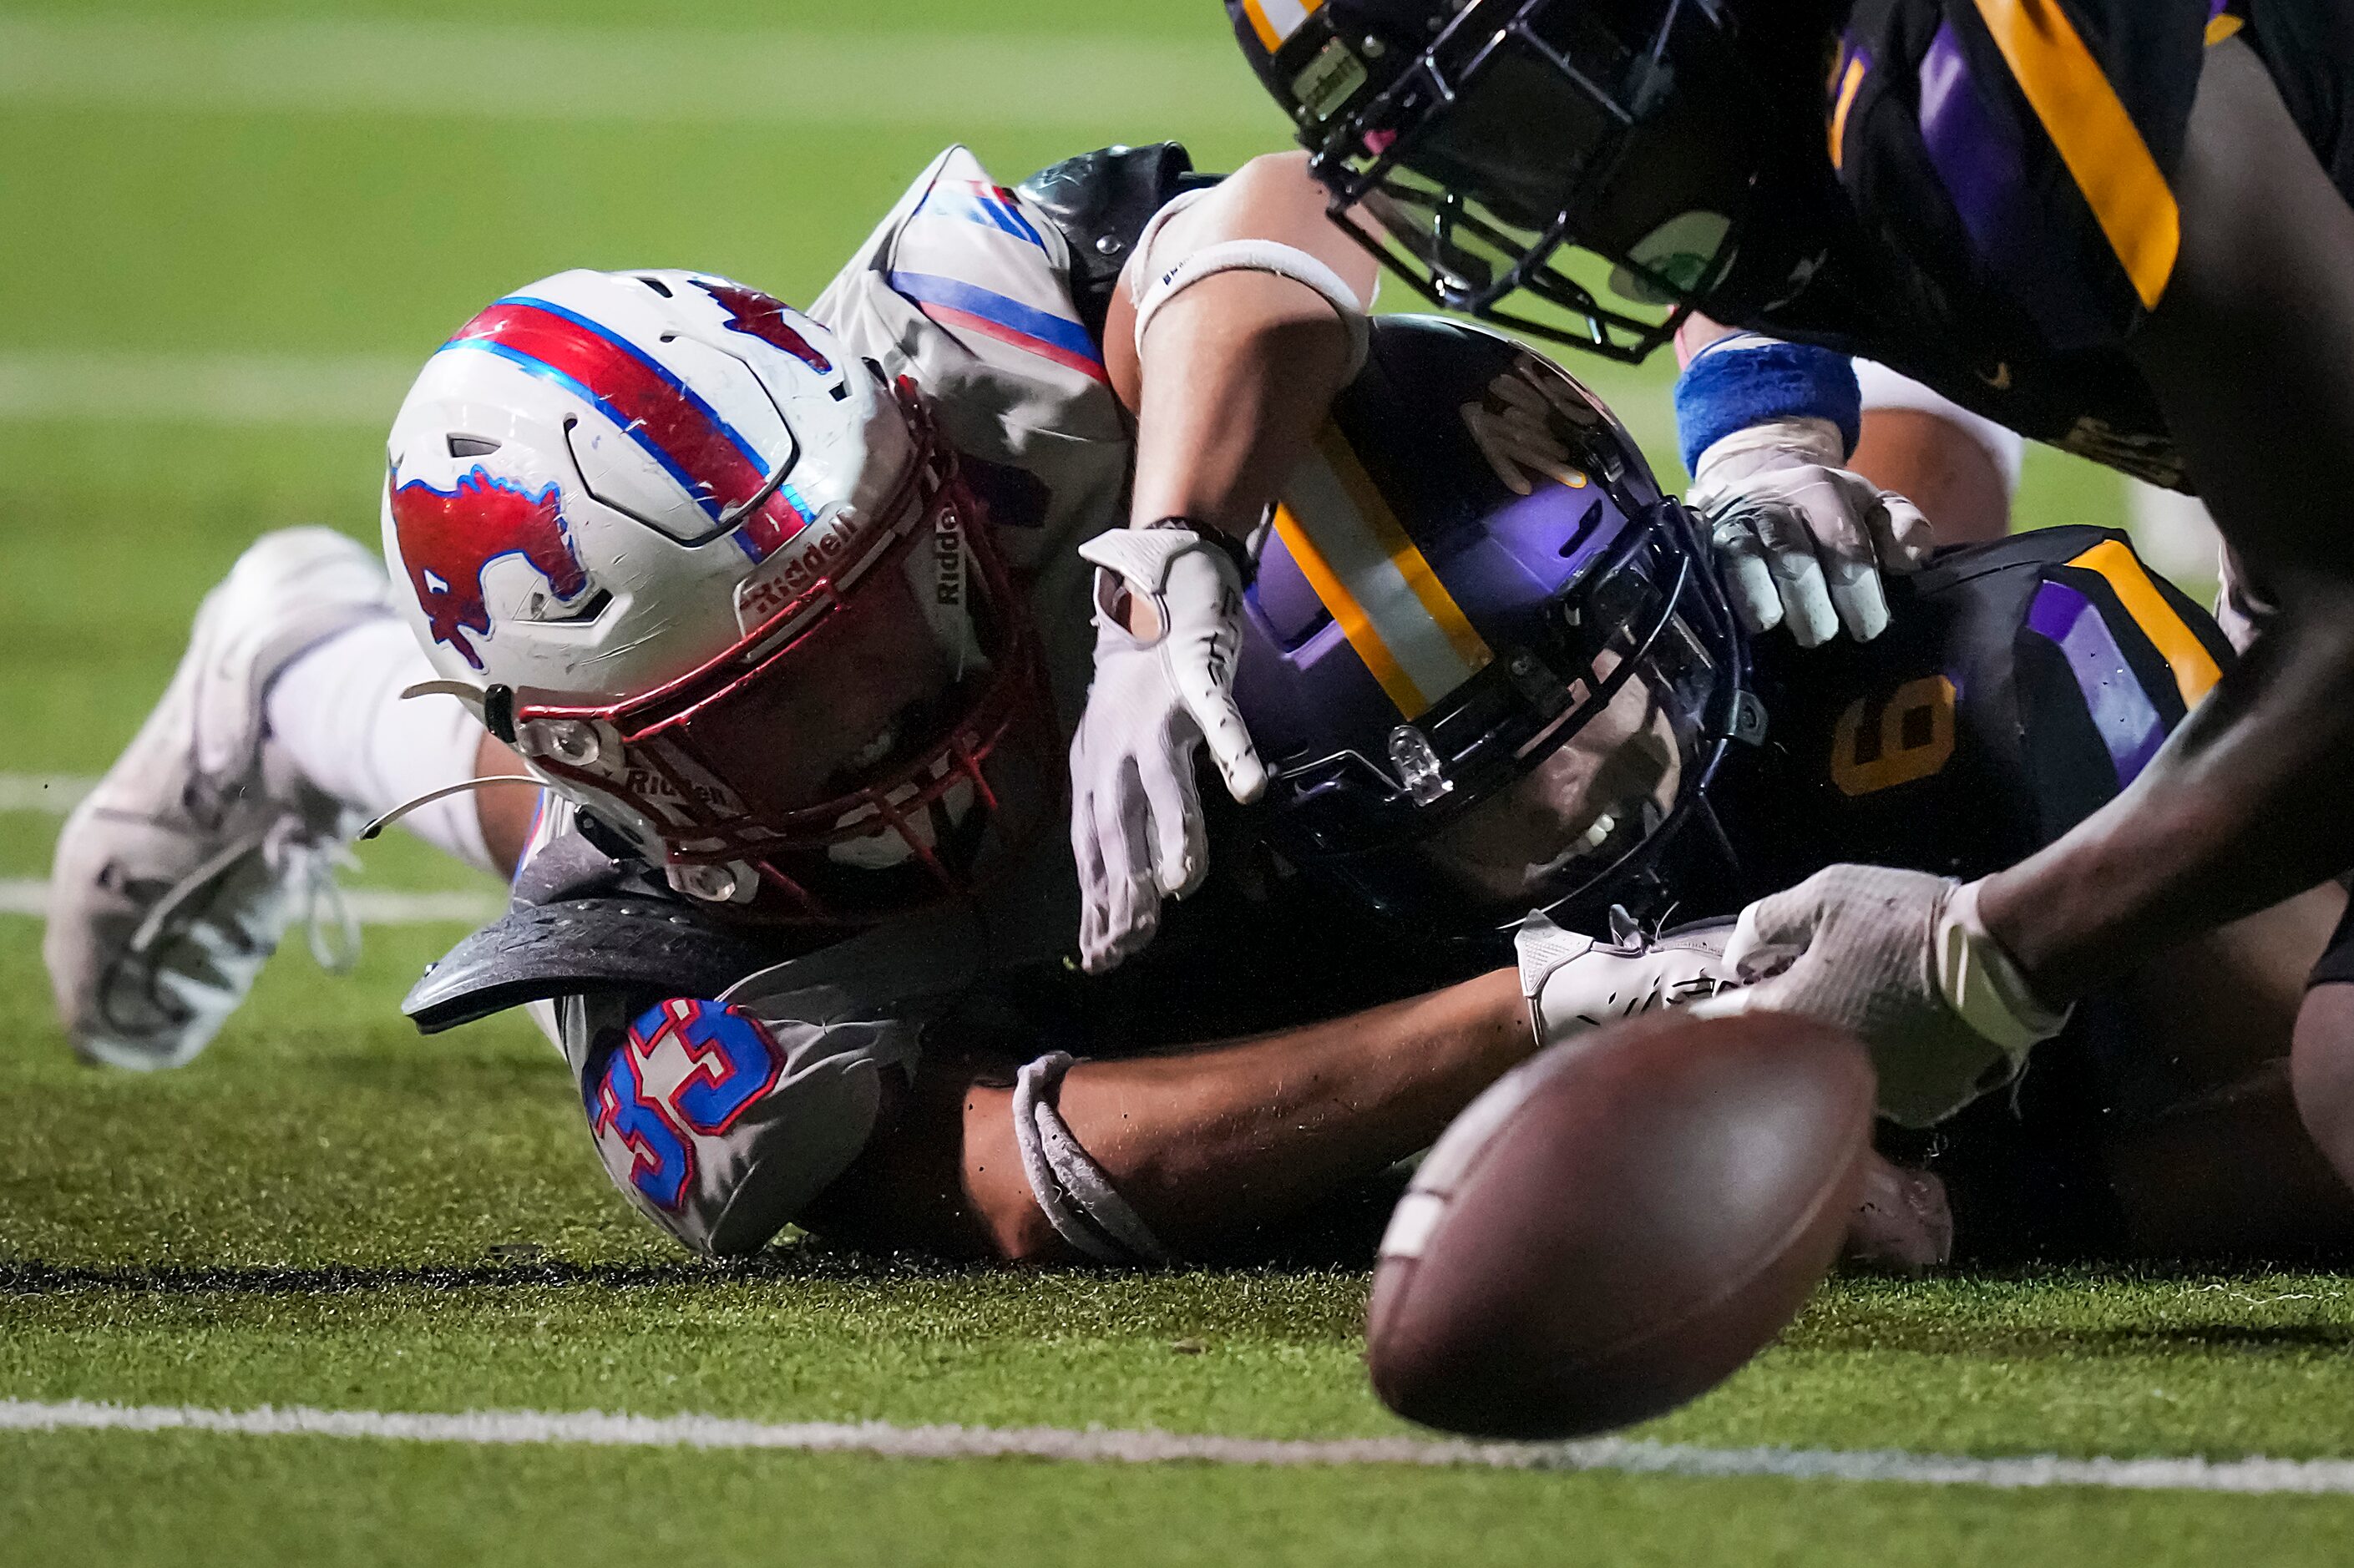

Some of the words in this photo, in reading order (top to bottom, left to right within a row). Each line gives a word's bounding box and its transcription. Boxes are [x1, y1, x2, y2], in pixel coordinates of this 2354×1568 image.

[740, 508, 858, 614] Riddell
[935, 507, 959, 604] Ridde
[582, 998, 787, 1212] 33
